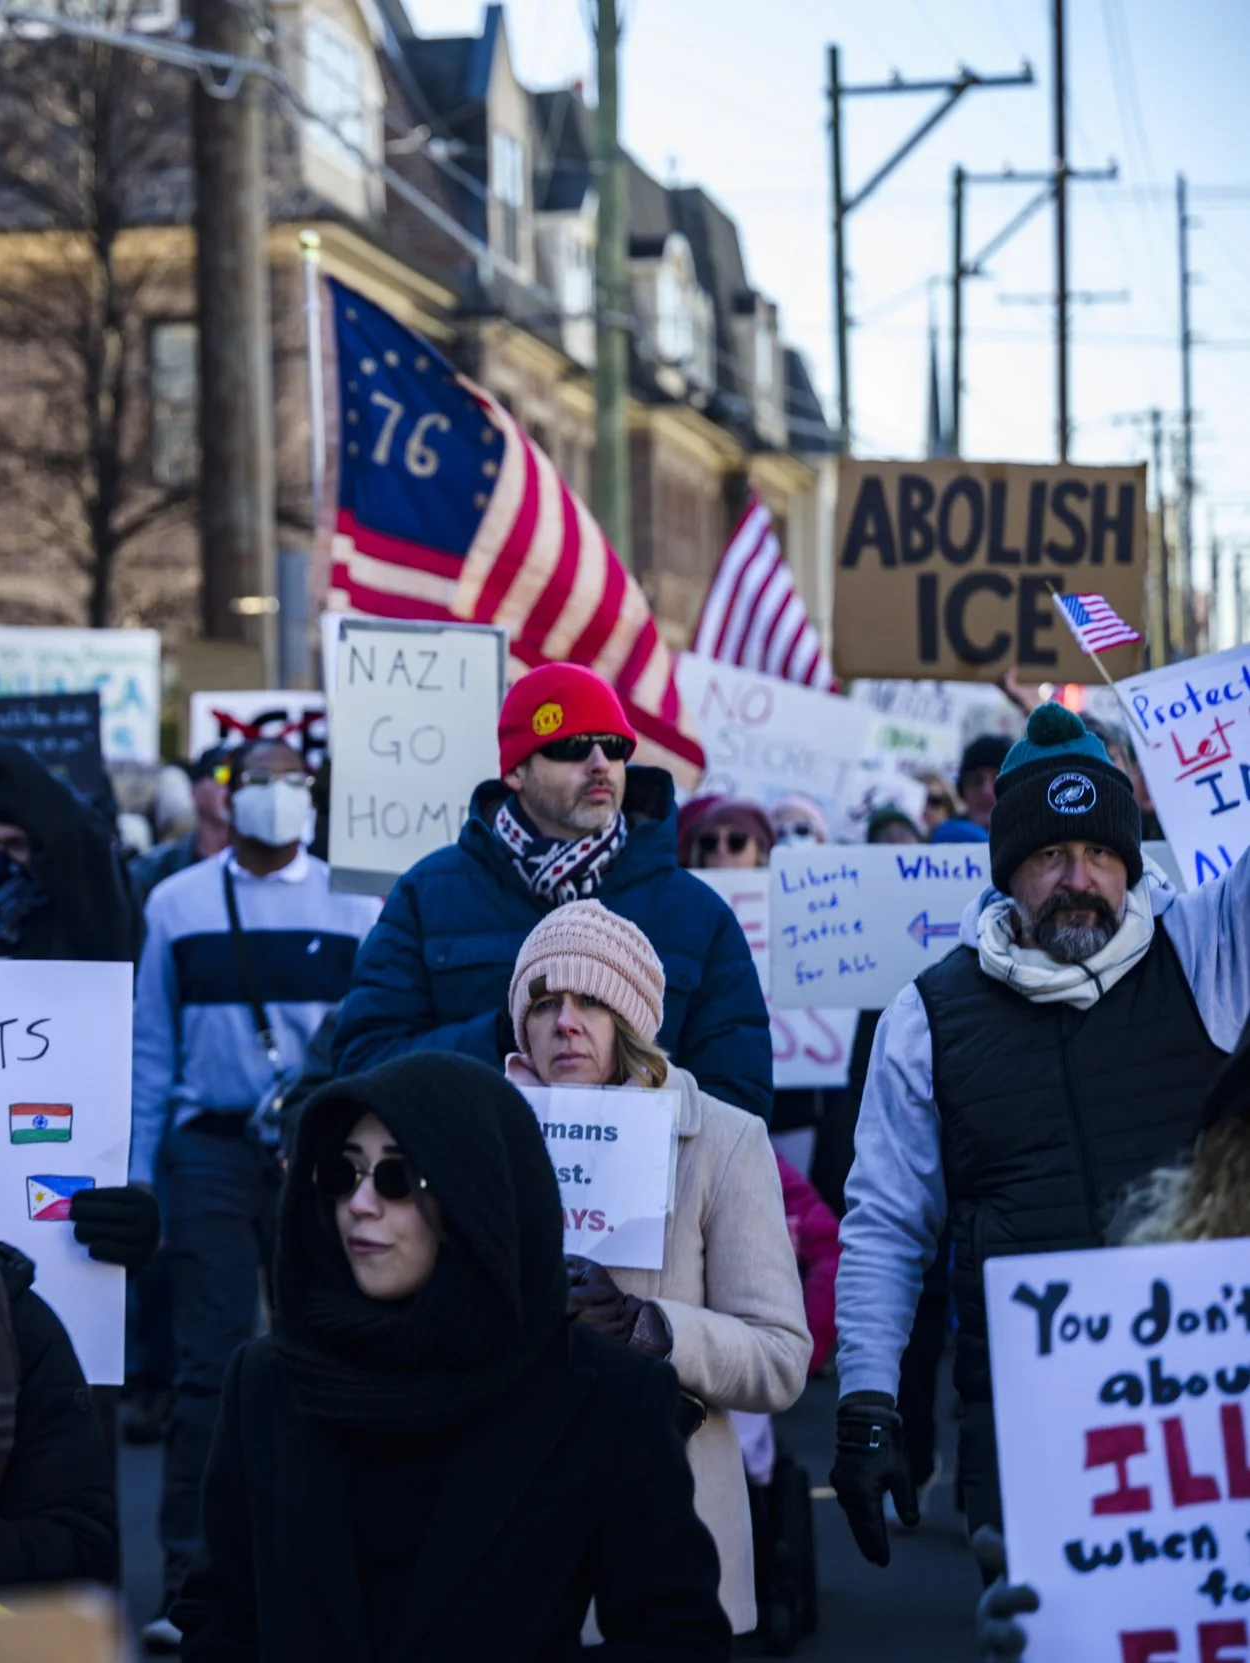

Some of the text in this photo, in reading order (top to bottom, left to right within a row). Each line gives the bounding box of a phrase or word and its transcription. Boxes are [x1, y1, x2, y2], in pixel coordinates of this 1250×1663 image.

[370, 391, 451, 478] 76
[841, 474, 1136, 568] ABOLISH
[917, 571, 1063, 666] ICE
[349, 645, 467, 691] NAZI
[700, 678, 775, 727] NO
[368, 714, 446, 766] GO
[897, 855, 982, 880] Which
[782, 918, 864, 948] Justice
[796, 961, 825, 986] for
[542, 1122, 619, 1142] mans
[556, 1164, 592, 1185] st.
[1012, 1278, 1250, 1357] You don't
[1084, 1402, 1250, 1517] ILL
[1065, 1525, 1219, 1574] when
